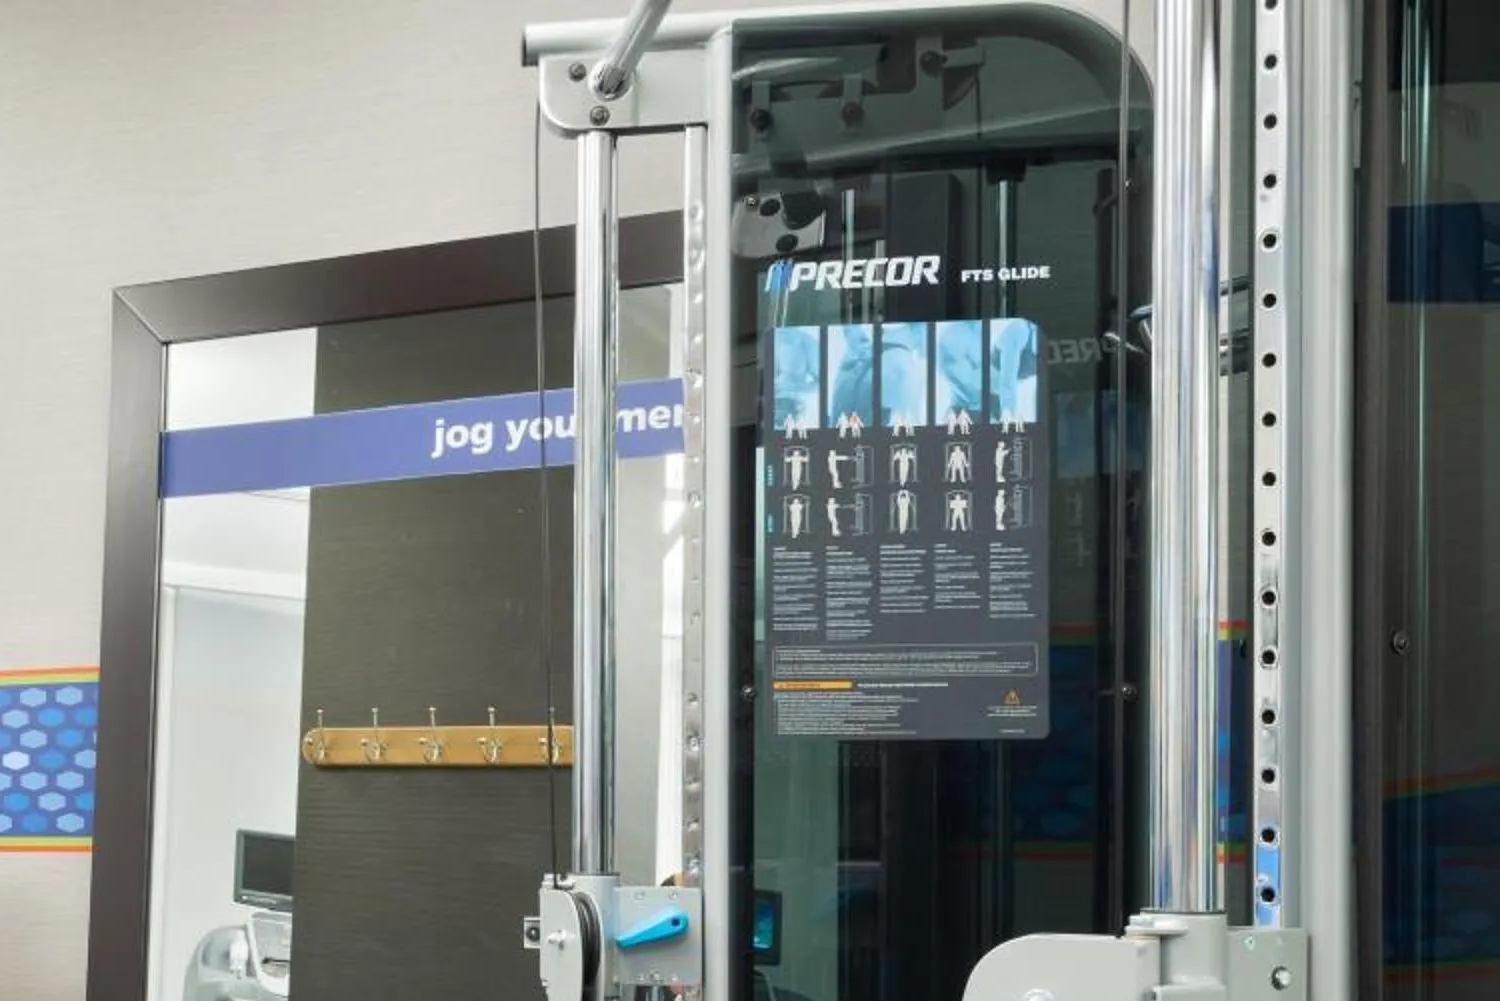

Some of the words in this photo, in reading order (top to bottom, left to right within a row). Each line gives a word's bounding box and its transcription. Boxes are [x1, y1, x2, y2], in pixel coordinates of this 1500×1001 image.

[788, 255, 941, 291] PRECOR
[961, 268, 994, 284] FTS
[998, 265, 1051, 282] GLIDE
[430, 418, 494, 459] jog
[505, 412, 577, 451] you
